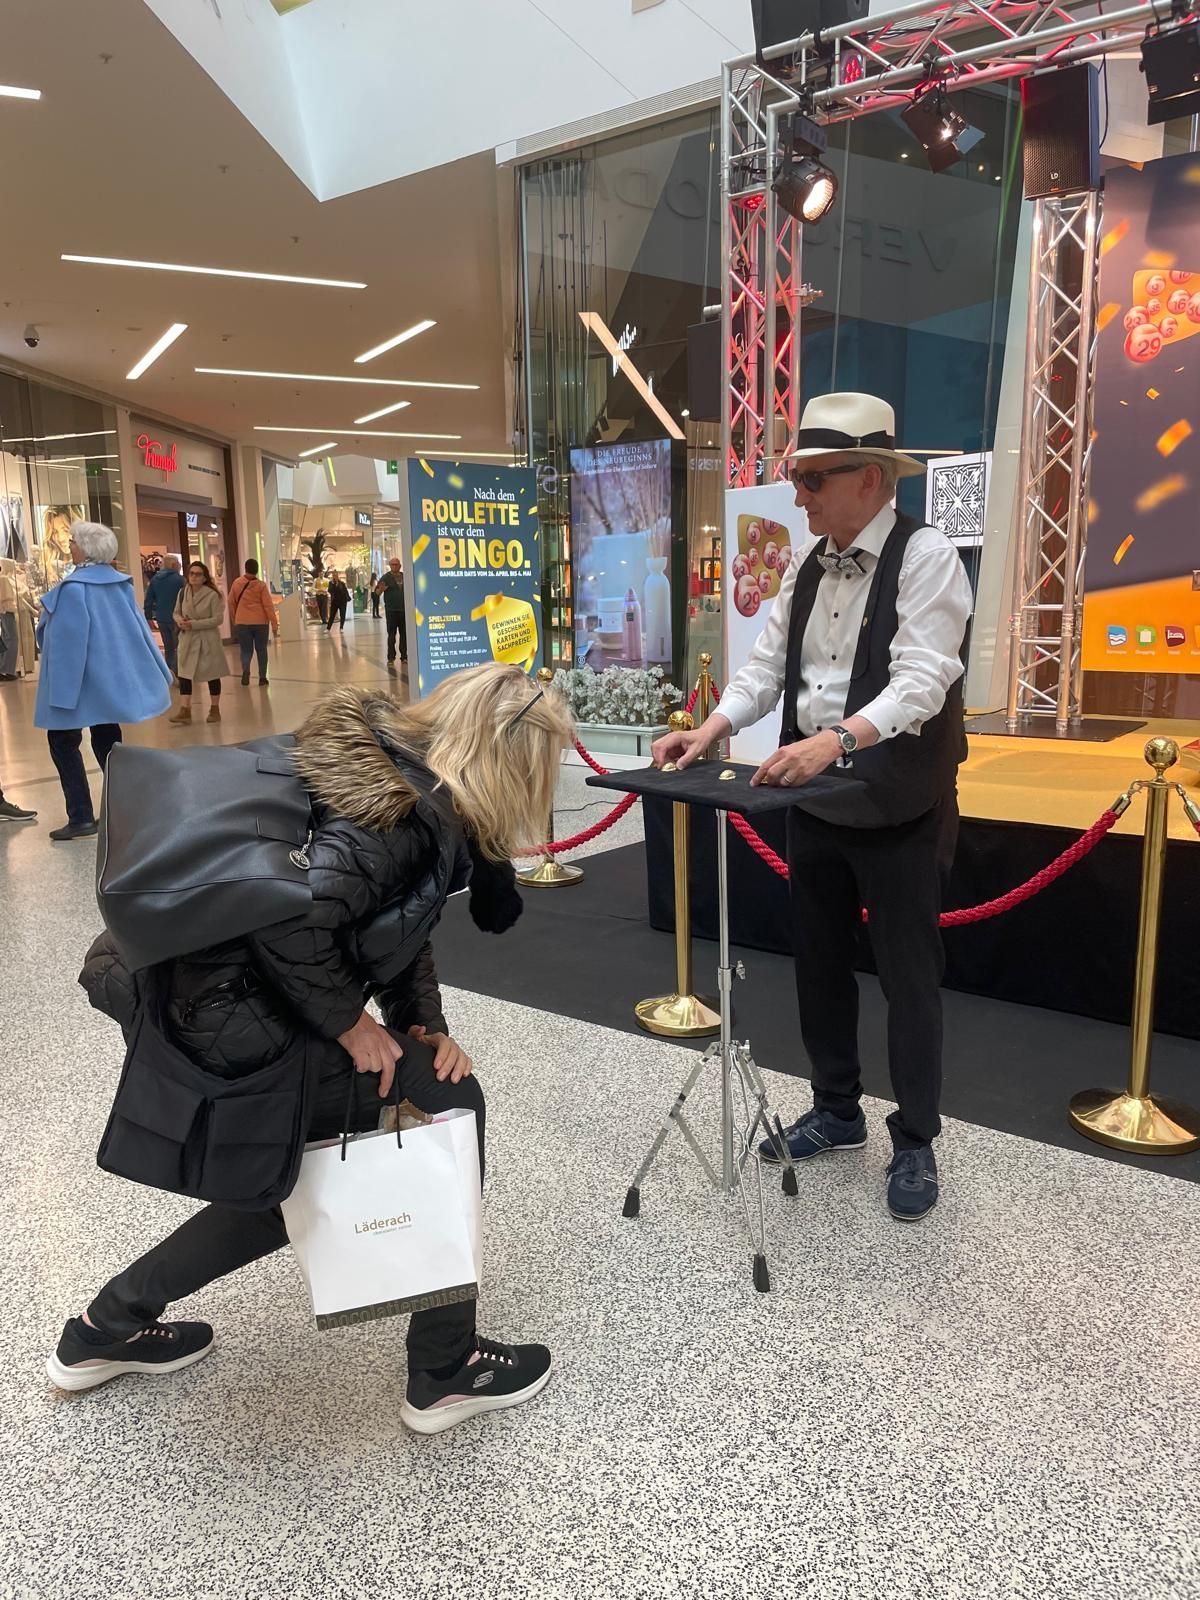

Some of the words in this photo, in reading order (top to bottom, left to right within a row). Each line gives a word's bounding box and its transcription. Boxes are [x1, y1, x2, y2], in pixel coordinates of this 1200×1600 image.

[1174, 299, 1186, 310] 16
[1137, 337, 1161, 357] 29
[137, 434, 177, 483] Triumph
[612, 446, 641, 456] FREUDE
[603, 454, 652, 465] NEUBEGINNS
[474, 487, 496, 500] Nach
[497, 488, 515, 501] dem
[421, 498, 520, 526] ROULETTE
[438, 525, 448, 536] ist
[449, 527, 464, 537] vor
[466, 525, 485, 537] dem
[437, 537, 531, 569] BINGO.
[767, 551, 777, 563] 16
[743, 591, 760, 610] 29
[491, 616, 521, 630] GEWINNEN
[521, 613, 530, 621] SIE
[496, 623, 528, 636] GESCHENK-
[496, 633, 519, 645] KARTEN
[519, 629, 531, 638] UND
[497, 635, 532, 652] SACHPREISE!
[354, 1212, 411, 1234] Läderach
